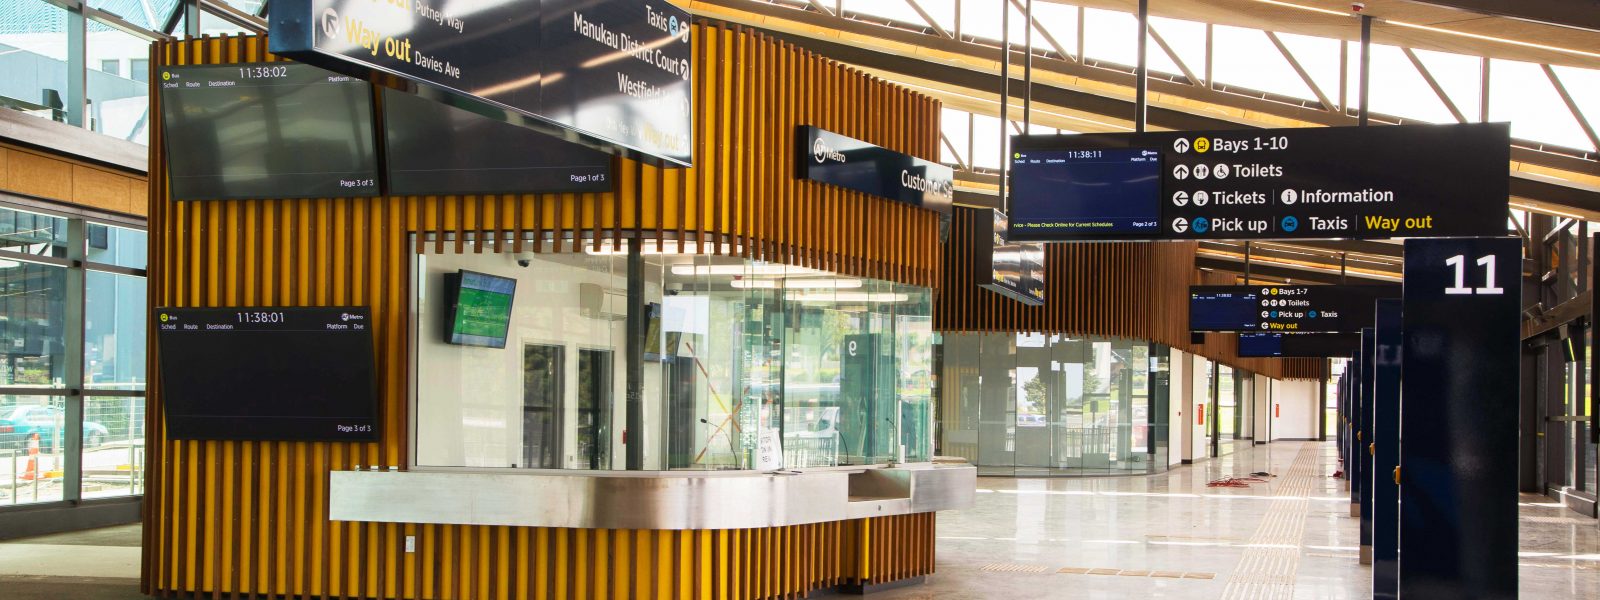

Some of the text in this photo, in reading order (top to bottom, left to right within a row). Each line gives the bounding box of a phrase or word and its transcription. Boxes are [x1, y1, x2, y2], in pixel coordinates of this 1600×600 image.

[415, 1, 444, 26] Putney
[445, 14, 464, 34] Way
[645, 5, 668, 32] Taxis
[345, 16, 411, 63] Way out
[573, 12, 680, 76] Manukau District Court
[239, 66, 287, 79] 11:38:02
[415, 51, 460, 79] Davies Ave
[617, 72, 660, 105] Westfield
[1213, 136, 1289, 154] Bays 1-10
[826, 146, 846, 163] Metro
[1068, 150, 1102, 159] 11:38:11
[570, 174, 587, 183] Page
[591, 173, 599, 181] of
[600, 173, 605, 181] 3
[1233, 164, 1283, 178] Toilets
[340, 179, 374, 188] Page 3 of 3
[901, 169, 942, 195] Customer
[1212, 188, 1394, 205] Tickets Information
[1212, 215, 1433, 235] Pick up Taxis Way out
[1444, 254, 1504, 295] 11
[1278, 288, 1295, 296] Bays
[1287, 299, 1310, 307] Toilets
[237, 312, 284, 323] 11:38:01
[1269, 322, 1285, 330] Way
[337, 424, 371, 433] Page 3 of 3
